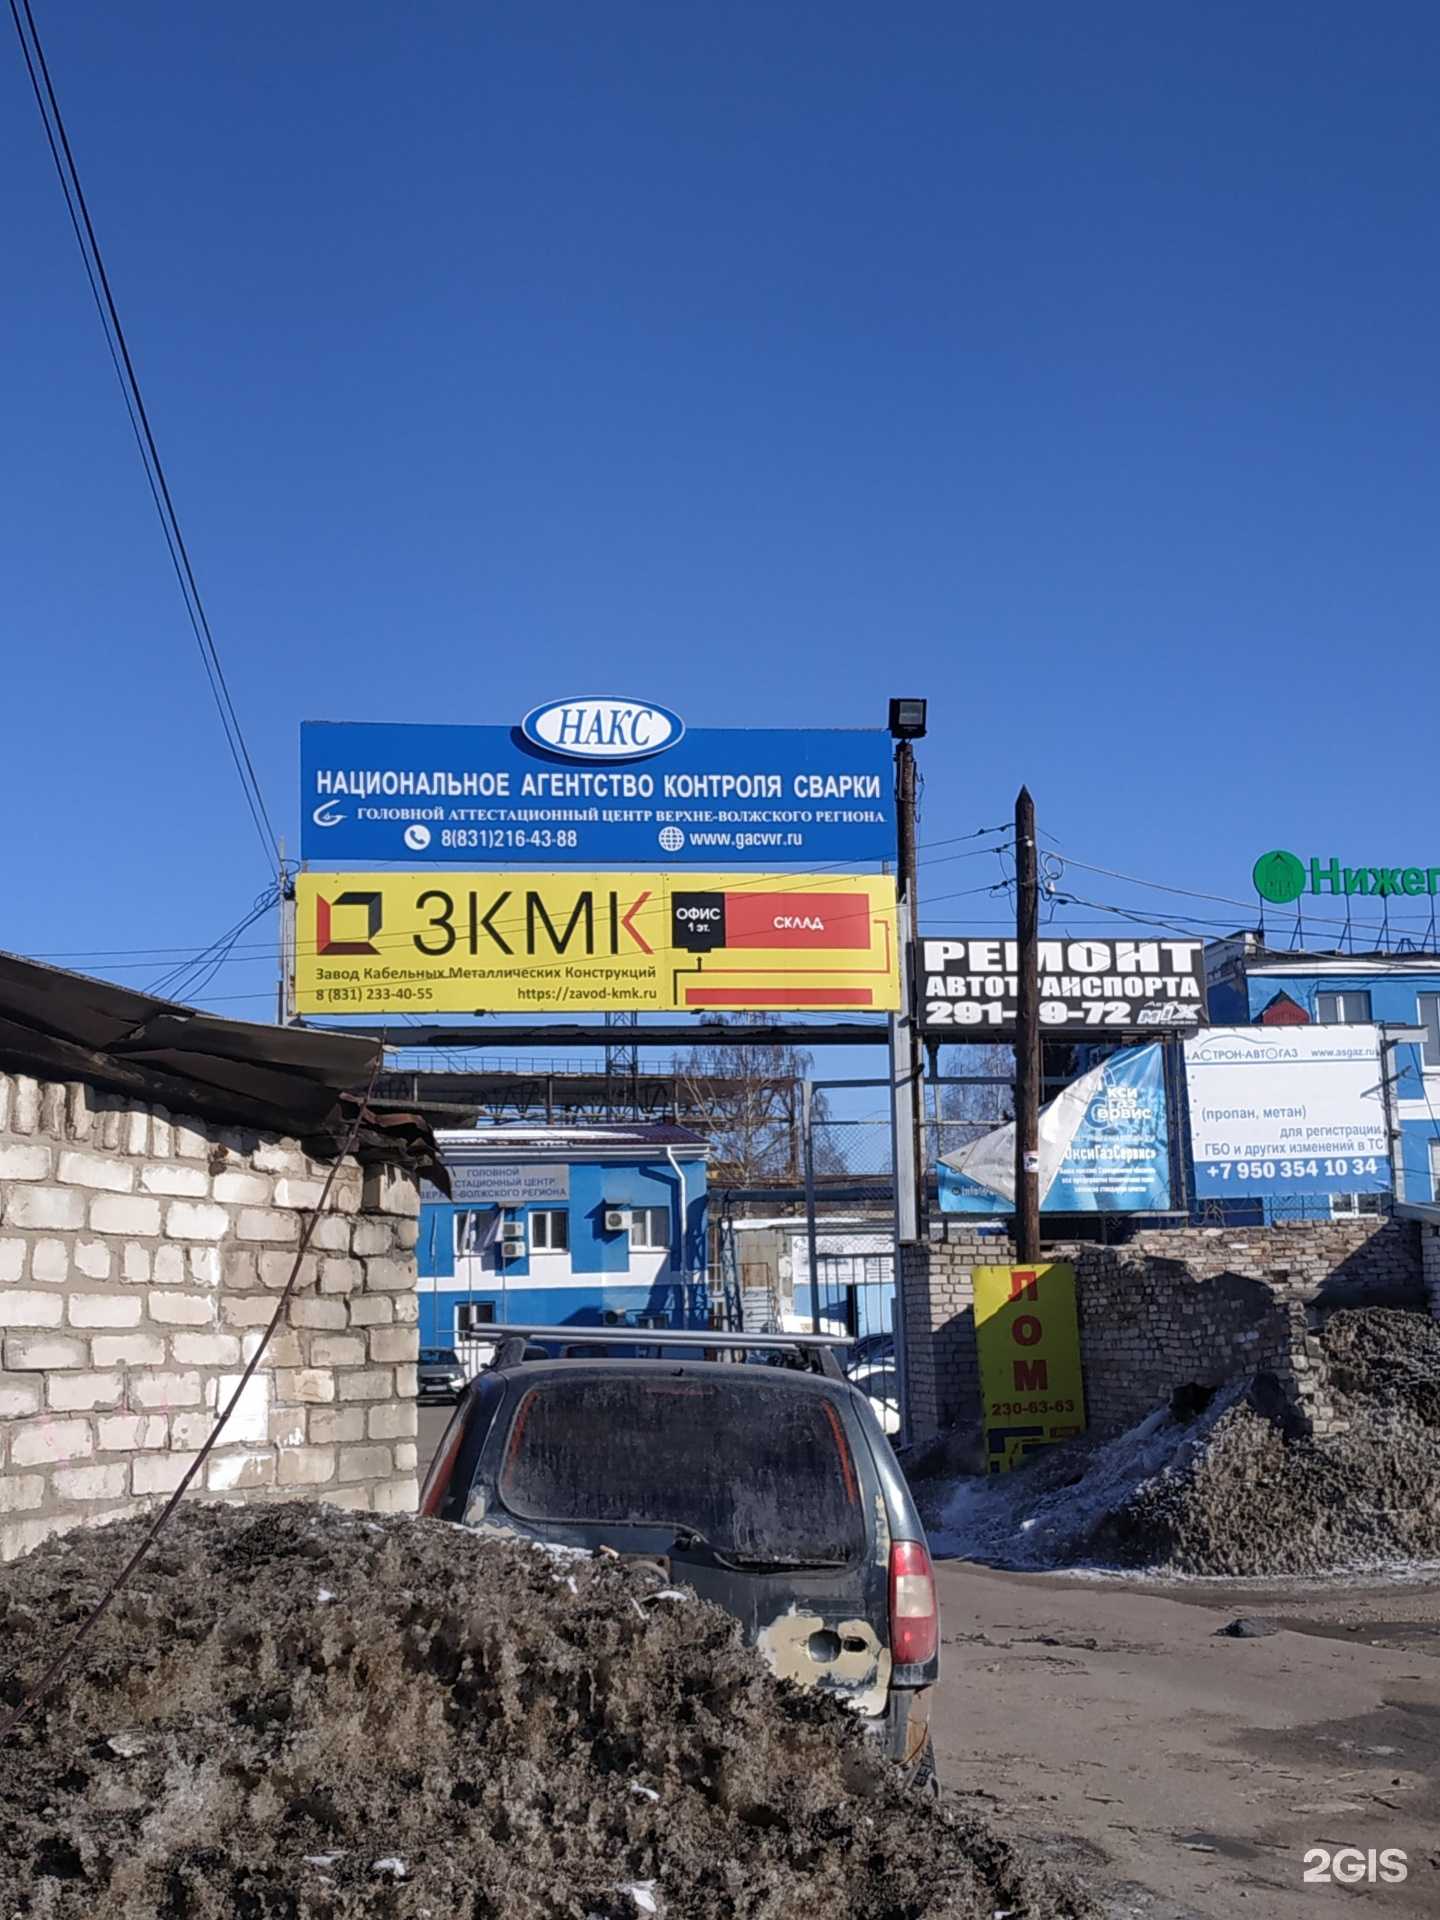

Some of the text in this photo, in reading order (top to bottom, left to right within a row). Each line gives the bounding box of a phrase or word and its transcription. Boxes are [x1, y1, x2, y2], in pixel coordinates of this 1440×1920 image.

[555, 709, 652, 746] НАКС
[317, 770, 880, 799] НАЦИОНАЛЬНОЕ АГЕНТСТВО КОНТРОЛЯ СВАРКИ
[357, 806, 884, 824] ГОЛОВНОЙ АТТЕСТАЦИОННЫЙ ЦЕНТР ВЕРХНЕ-ВОЛЖСКОГО РЕГИОНА
[441, 829, 577, 848] 8(831)216-43-88
[690, 832, 802, 849] www.gacvvr.ru
[676, 907, 721, 921] ОФИС
[413, 890, 655, 956] ЗКМК
[687, 923, 694, 932] 1
[774, 915, 824, 931] СКЛАД
[924, 941, 1202, 973] РЕМОНТ
[316, 965, 656, 981] Завод Кабельных Металлических Конструкций
[316, 988, 433, 1001] 8 (831) 233-40-55
[517, 986, 657, 1001] https://zavod-kmk.ru
[926, 976, 1200, 998] АВТОТАНСПОРТА
[926, 1001, 1131, 1025] 291-9-72
[1192, 1048, 1298, 1061] АСТРОН-АВТОГАЗ
[1202, 1105, 1306, 1122] (пропан, метан)
[1280, 1125, 1381, 1140] для регистрации
[1205, 1138, 1384, 1157] ГБО и других изменений в ТС
[466, 1168, 519, 1177] ГОЛОВНОЙ
[1207, 1158, 1377, 1179] +7 950 354 10 34
[454, 1178, 555, 1188] СТАЦИОННЫЙ ЦЕНТР
[521, 1188, 566, 1197] РЕГИОНА
[1008, 1271, 1048, 1391] ЛОМ
